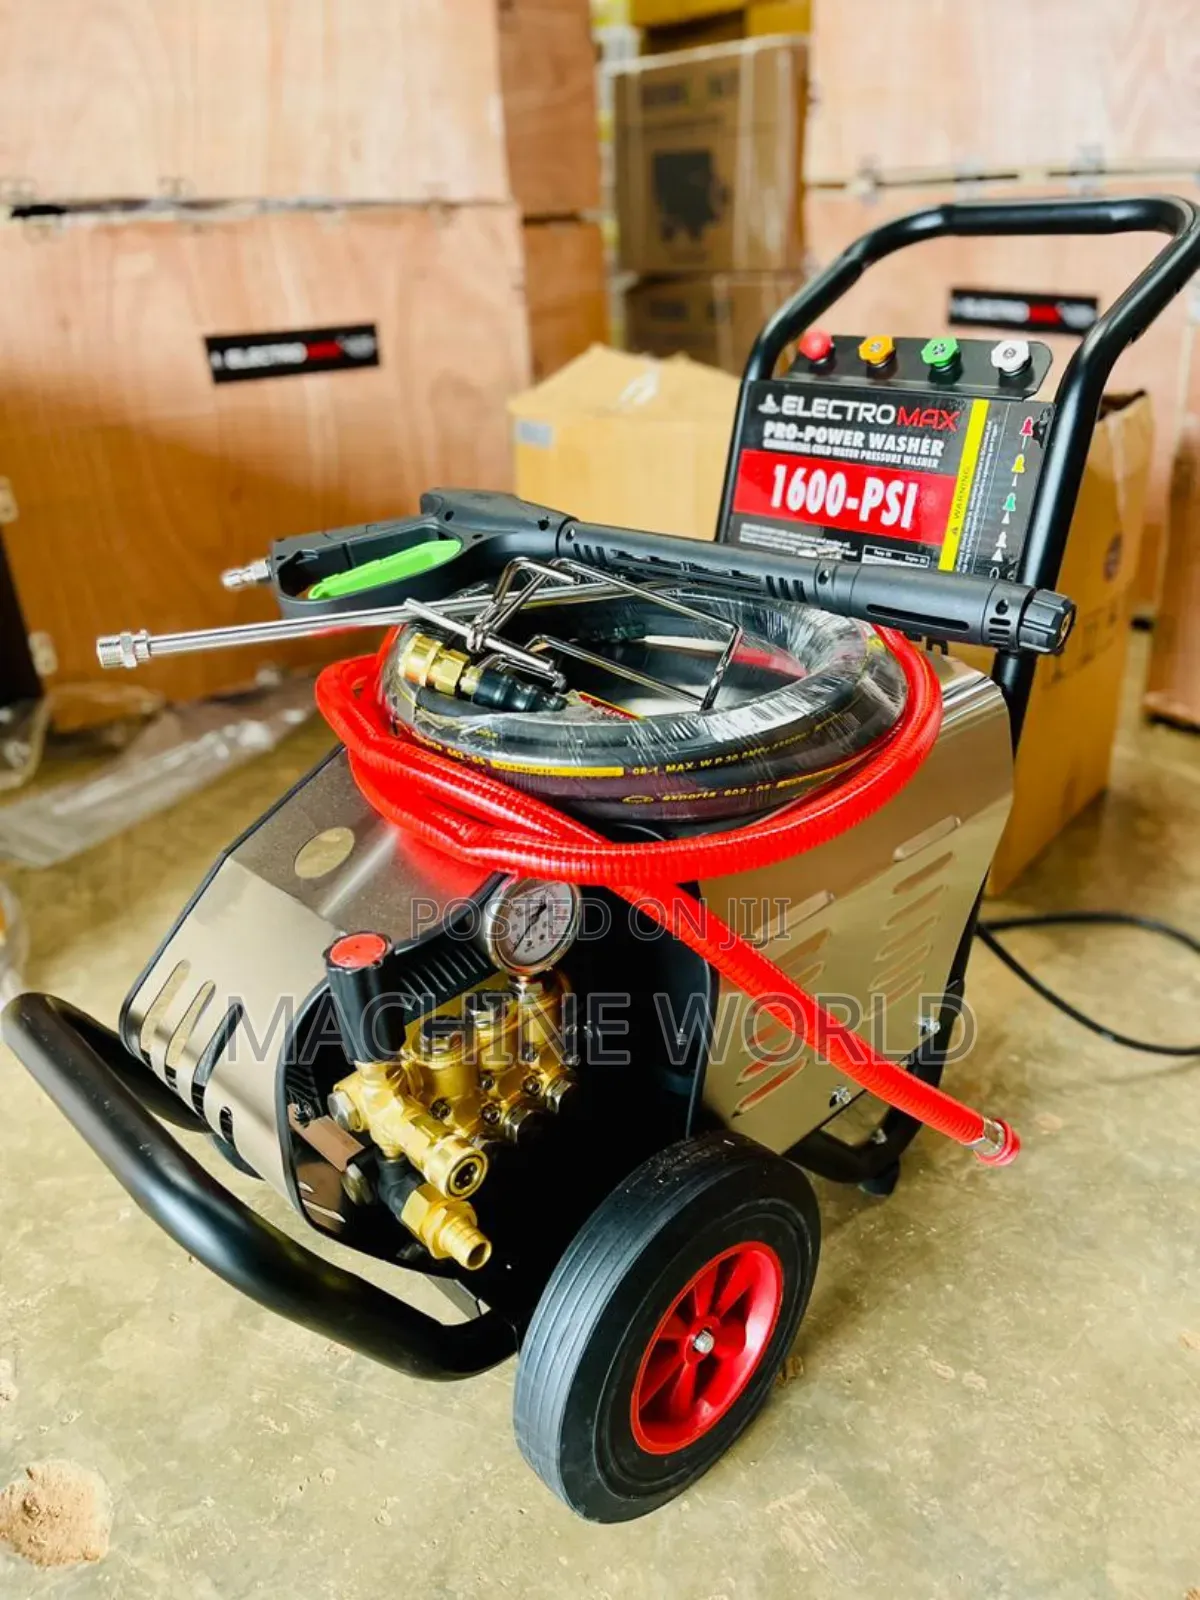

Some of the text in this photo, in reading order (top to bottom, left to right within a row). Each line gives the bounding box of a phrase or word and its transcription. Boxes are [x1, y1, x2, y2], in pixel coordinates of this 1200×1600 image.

[781, 394, 960, 432] ELECTROMAX
[763, 420, 866, 448] PRO-POWER
[868, 432, 945, 457] WASHER
[860, 450, 902, 464] PRESSURE
[903, 455, 940, 469] WASHER
[770, 464, 919, 531] 1600-PSI
[953, 466, 971, 519] WARNING
